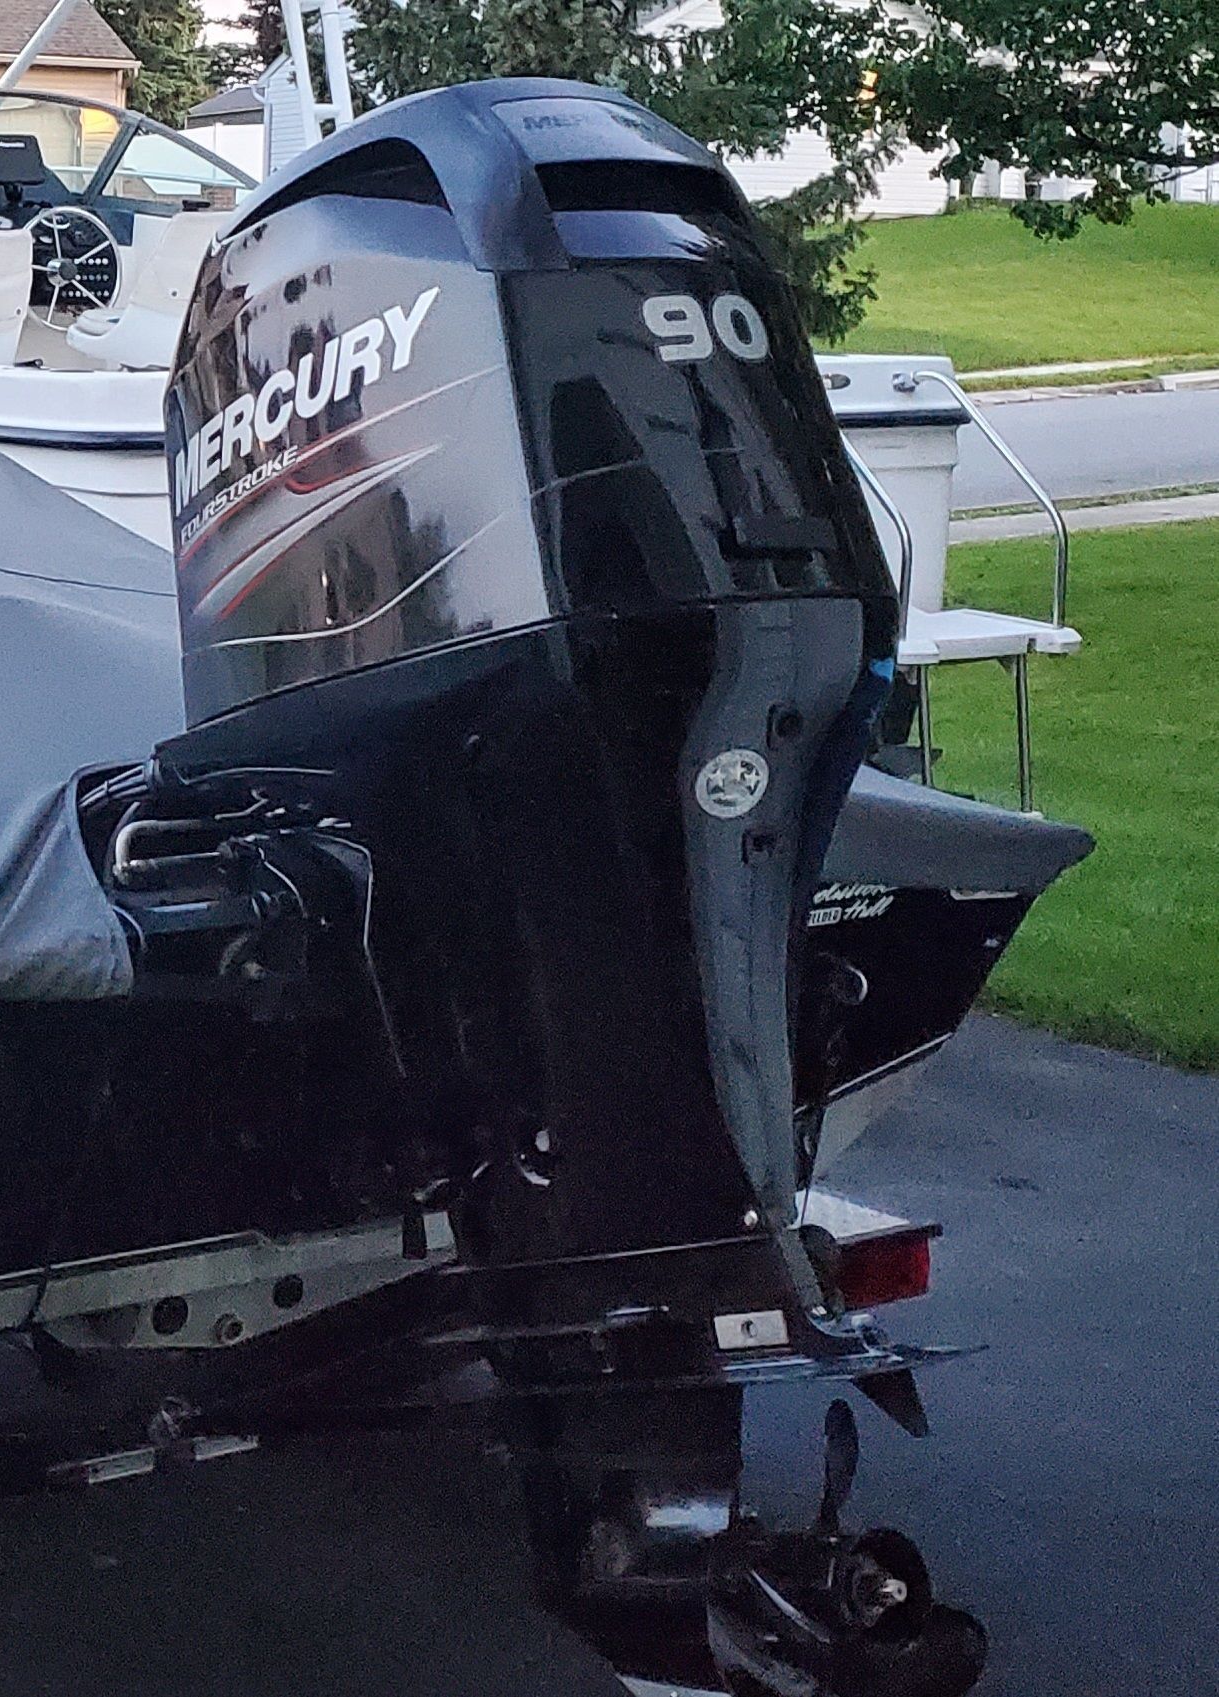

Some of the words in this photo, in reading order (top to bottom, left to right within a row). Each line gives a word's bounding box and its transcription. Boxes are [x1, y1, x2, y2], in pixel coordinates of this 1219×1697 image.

[641, 295, 769, 363] 90
[175, 286, 439, 517] MERCURY
[180, 445, 299, 545] FOURSTROKE
